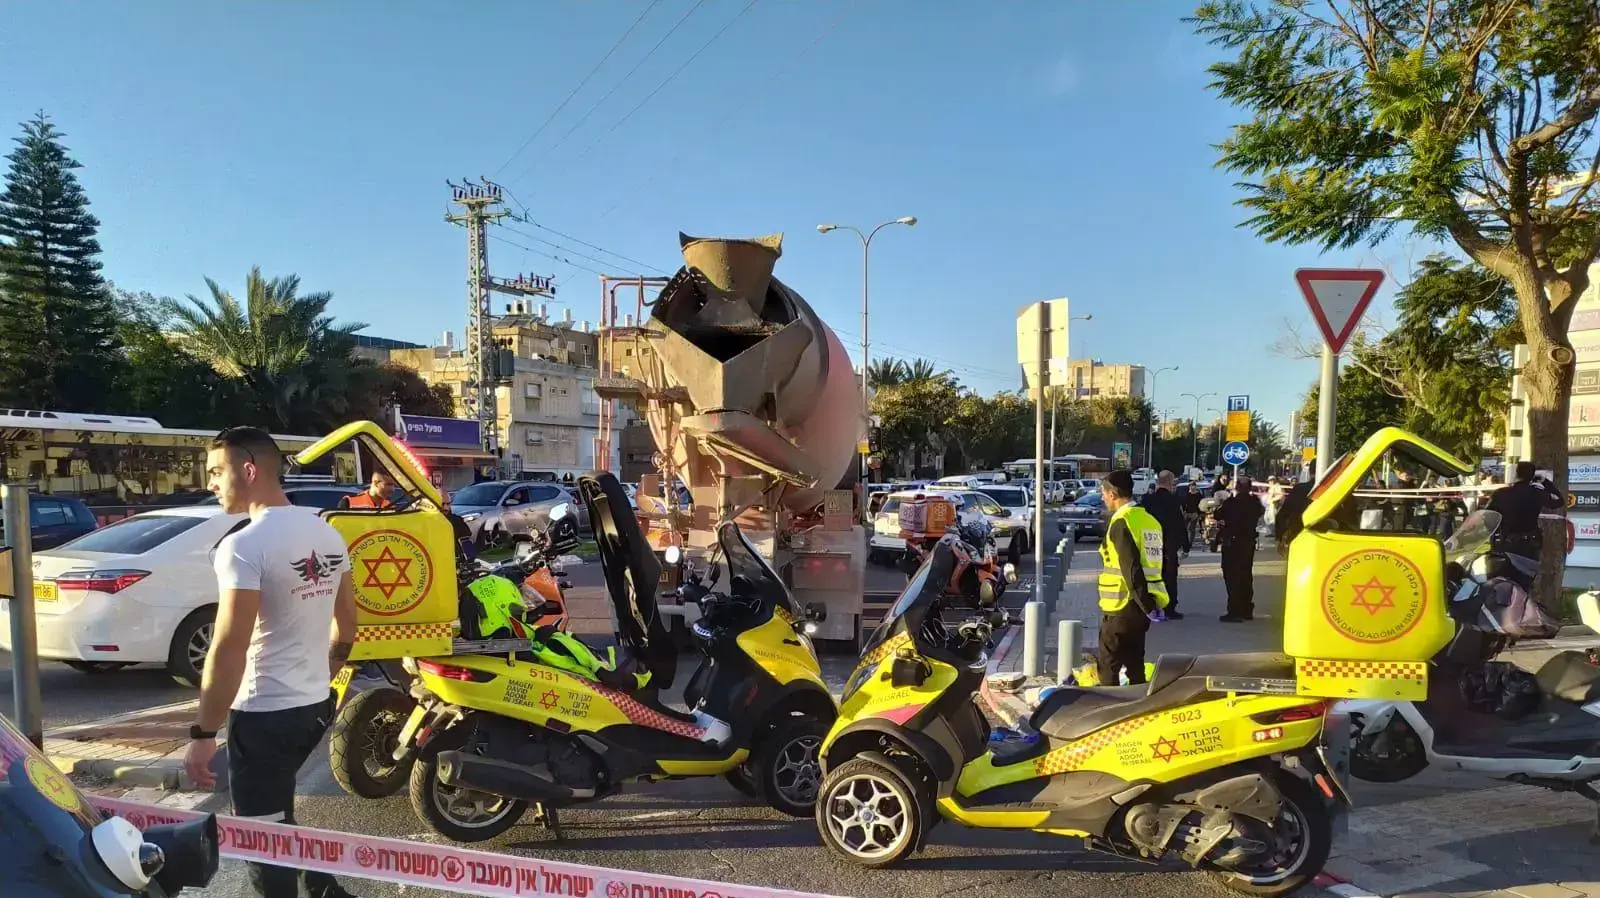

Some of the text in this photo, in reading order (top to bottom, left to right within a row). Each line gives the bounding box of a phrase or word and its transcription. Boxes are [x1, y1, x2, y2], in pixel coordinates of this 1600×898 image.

[407, 423, 442, 433] מפעל הפיס
[377, 535, 401, 544] אדום
[1331, 553, 1419, 589] מגן דוד אדום בישראל
[358, 594, 382, 610] DAVID
[384, 598, 410, 611] ADOM
[416, 565, 428, 592] ISRAEL
[1327, 595, 1420, 639] MAGEN DAVID ADOM IN ISRAEL
[529, 668, 559, 683] 5131
[506, 684, 529, 695] DAVID
[508, 679, 534, 690] MAGEN
[505, 690, 527, 701] ADOM
[572, 701, 591, 711] אדום
[1171, 709, 1202, 725] 5023
[1178, 726, 1220, 741] מגן דוד
[1194, 734, 1223, 747] אדום
[1115, 740, 1143, 749] MAGEN
[1120, 753, 1144, 761] ADOM
[226, 827, 269, 853] מעבר
[271, 833, 293, 859] אין
[294, 830, 344, 862] ישראל
[376, 848, 438, 877] משטרת
[466, 860, 512, 888] מעבר
[515, 867, 537, 894] אין
[540, 865, 594, 898] ישראל
